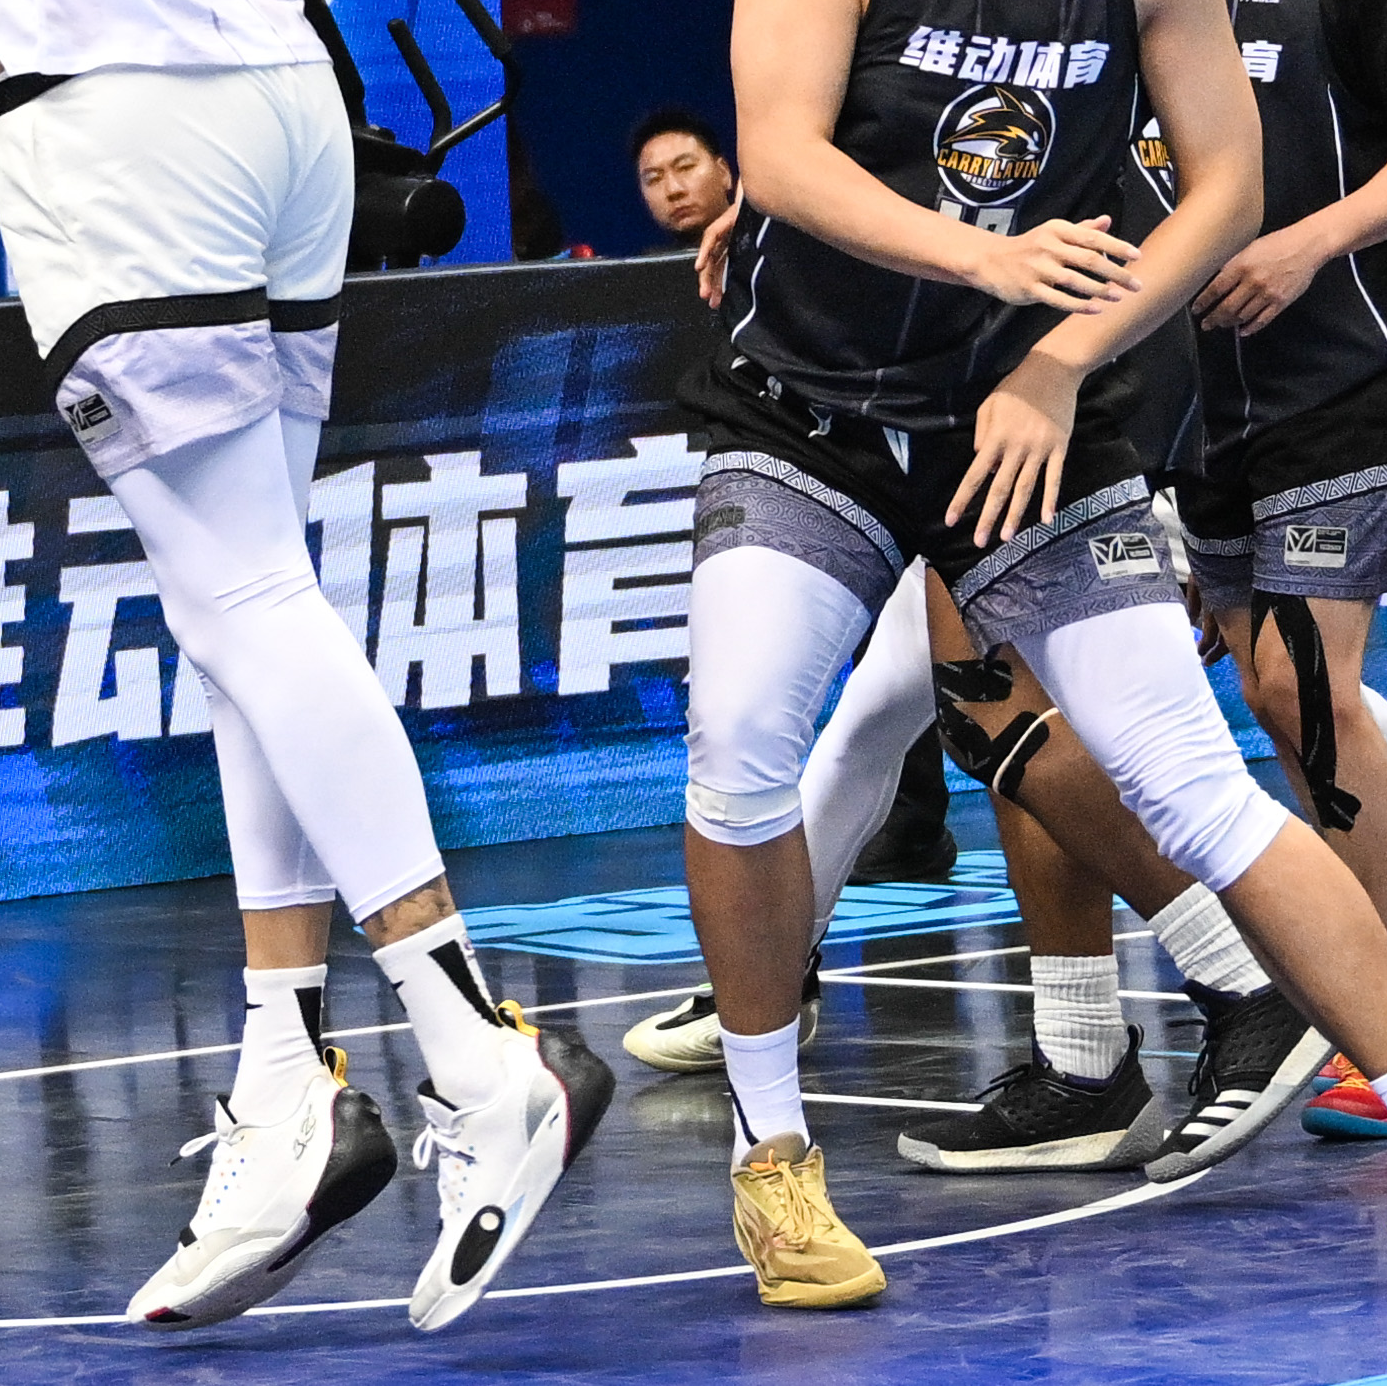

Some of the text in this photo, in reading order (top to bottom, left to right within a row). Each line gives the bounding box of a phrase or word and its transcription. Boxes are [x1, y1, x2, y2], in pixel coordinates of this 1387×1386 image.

[898, 25, 1111, 91] 维动体育
[937, 148, 993, 178] CARRY
